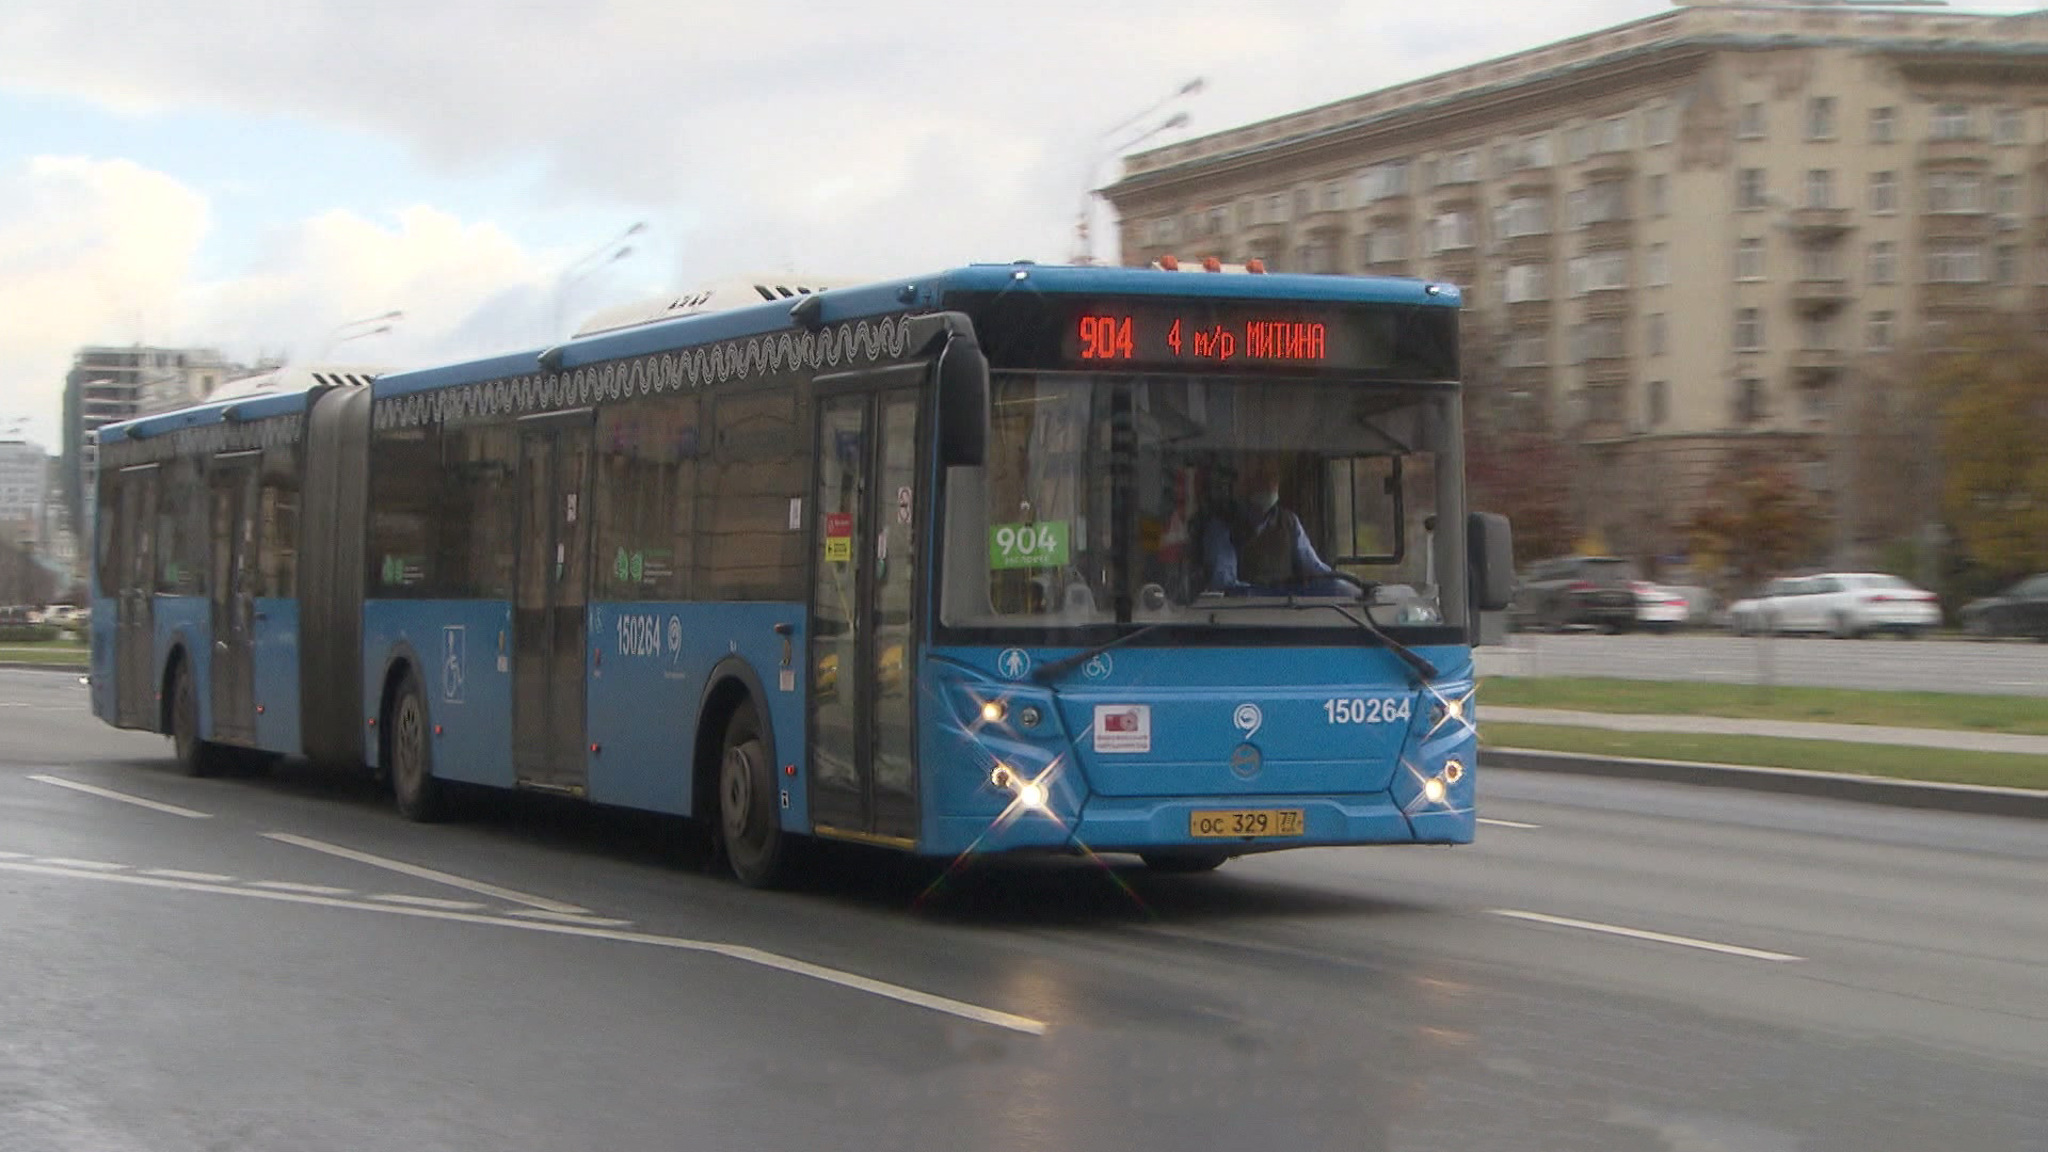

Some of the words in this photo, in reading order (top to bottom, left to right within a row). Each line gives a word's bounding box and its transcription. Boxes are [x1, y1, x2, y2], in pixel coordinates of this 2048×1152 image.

[1079, 316, 1133, 359] 904
[1168, 319, 1182, 355] 4
[1194, 325, 1235, 361] м/р
[1246, 321, 1326, 359] МИТИНА
[996, 526, 1058, 555] 904
[616, 614, 662, 657] 150264
[1323, 697, 1411, 724] 150264
[1232, 813, 1268, 833] 329
[1280, 811, 1297, 826] 77
